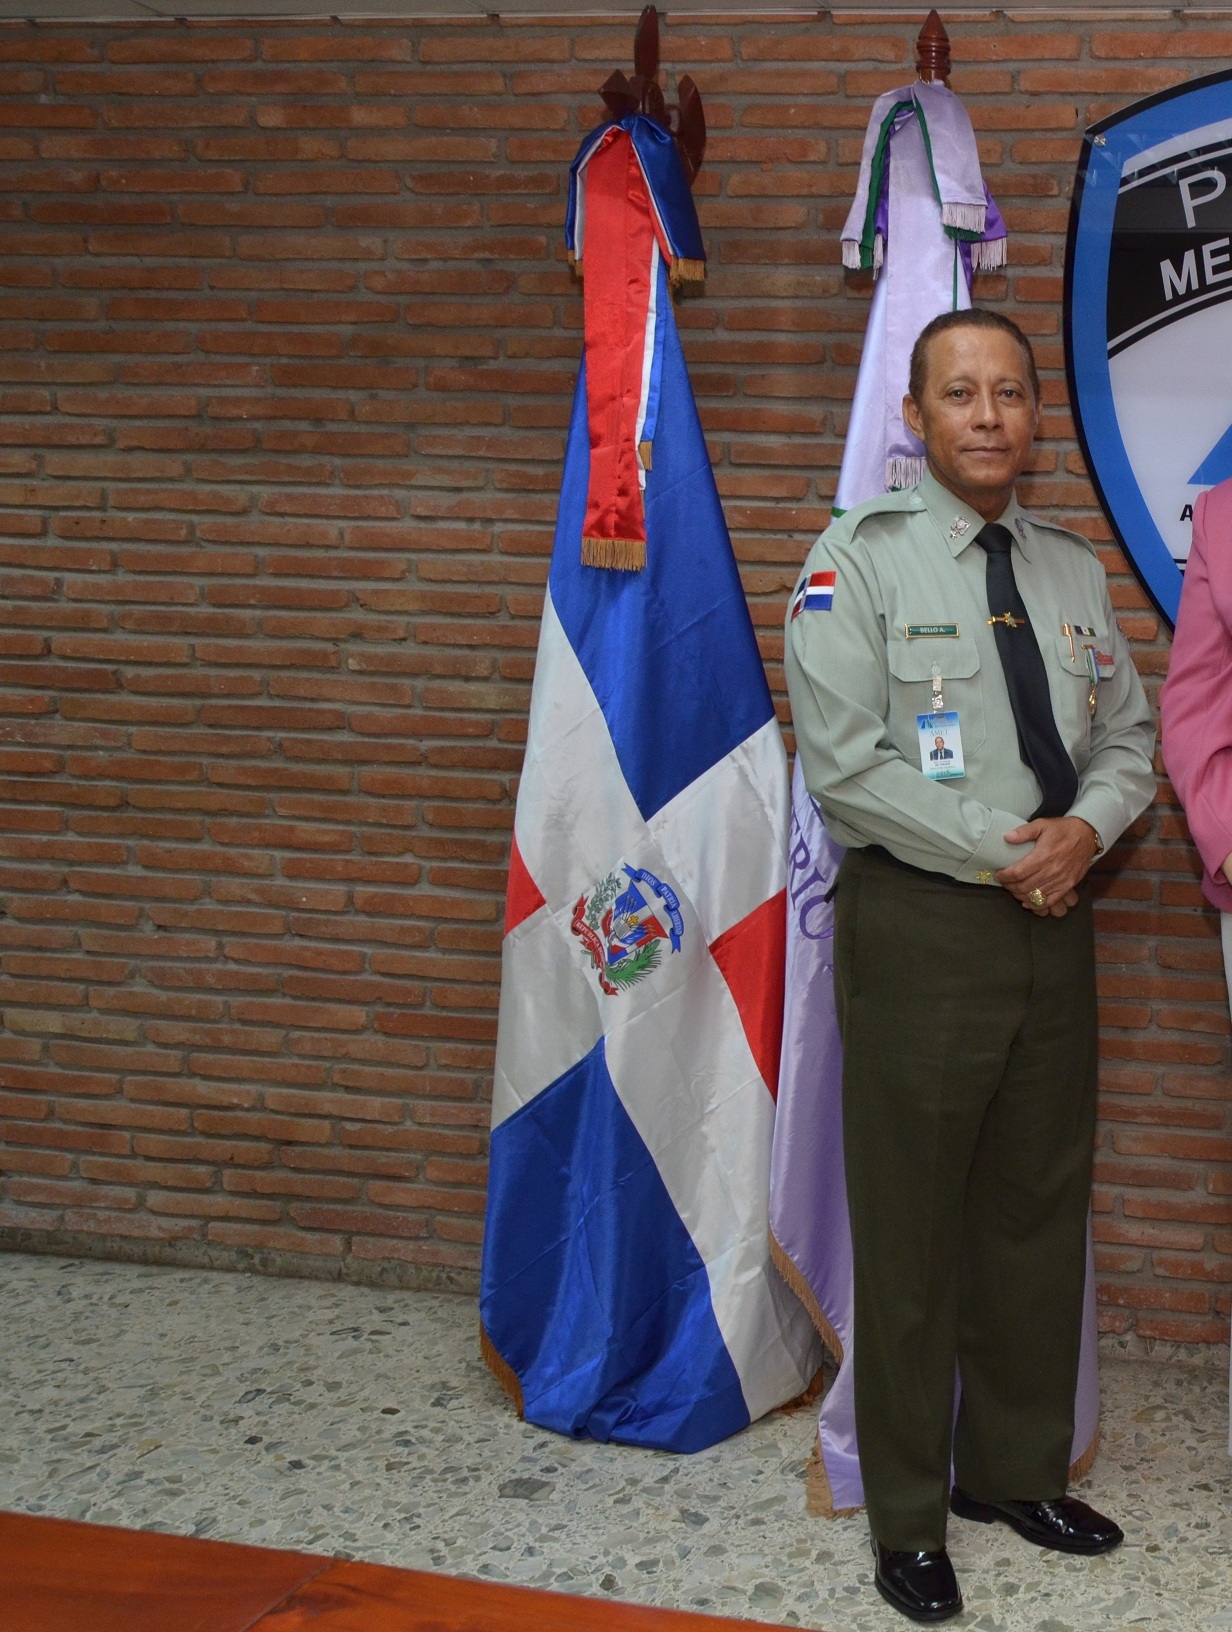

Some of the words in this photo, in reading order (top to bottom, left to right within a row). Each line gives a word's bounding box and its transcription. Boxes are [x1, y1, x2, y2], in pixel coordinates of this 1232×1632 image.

[920, 626, 939, 634] BELLO
[930, 729, 949, 737] AMET
[641, 871, 656, 887] DIOS
[661, 886, 678, 909] PATRIA
[576, 921, 600, 948] REPUBLICA
